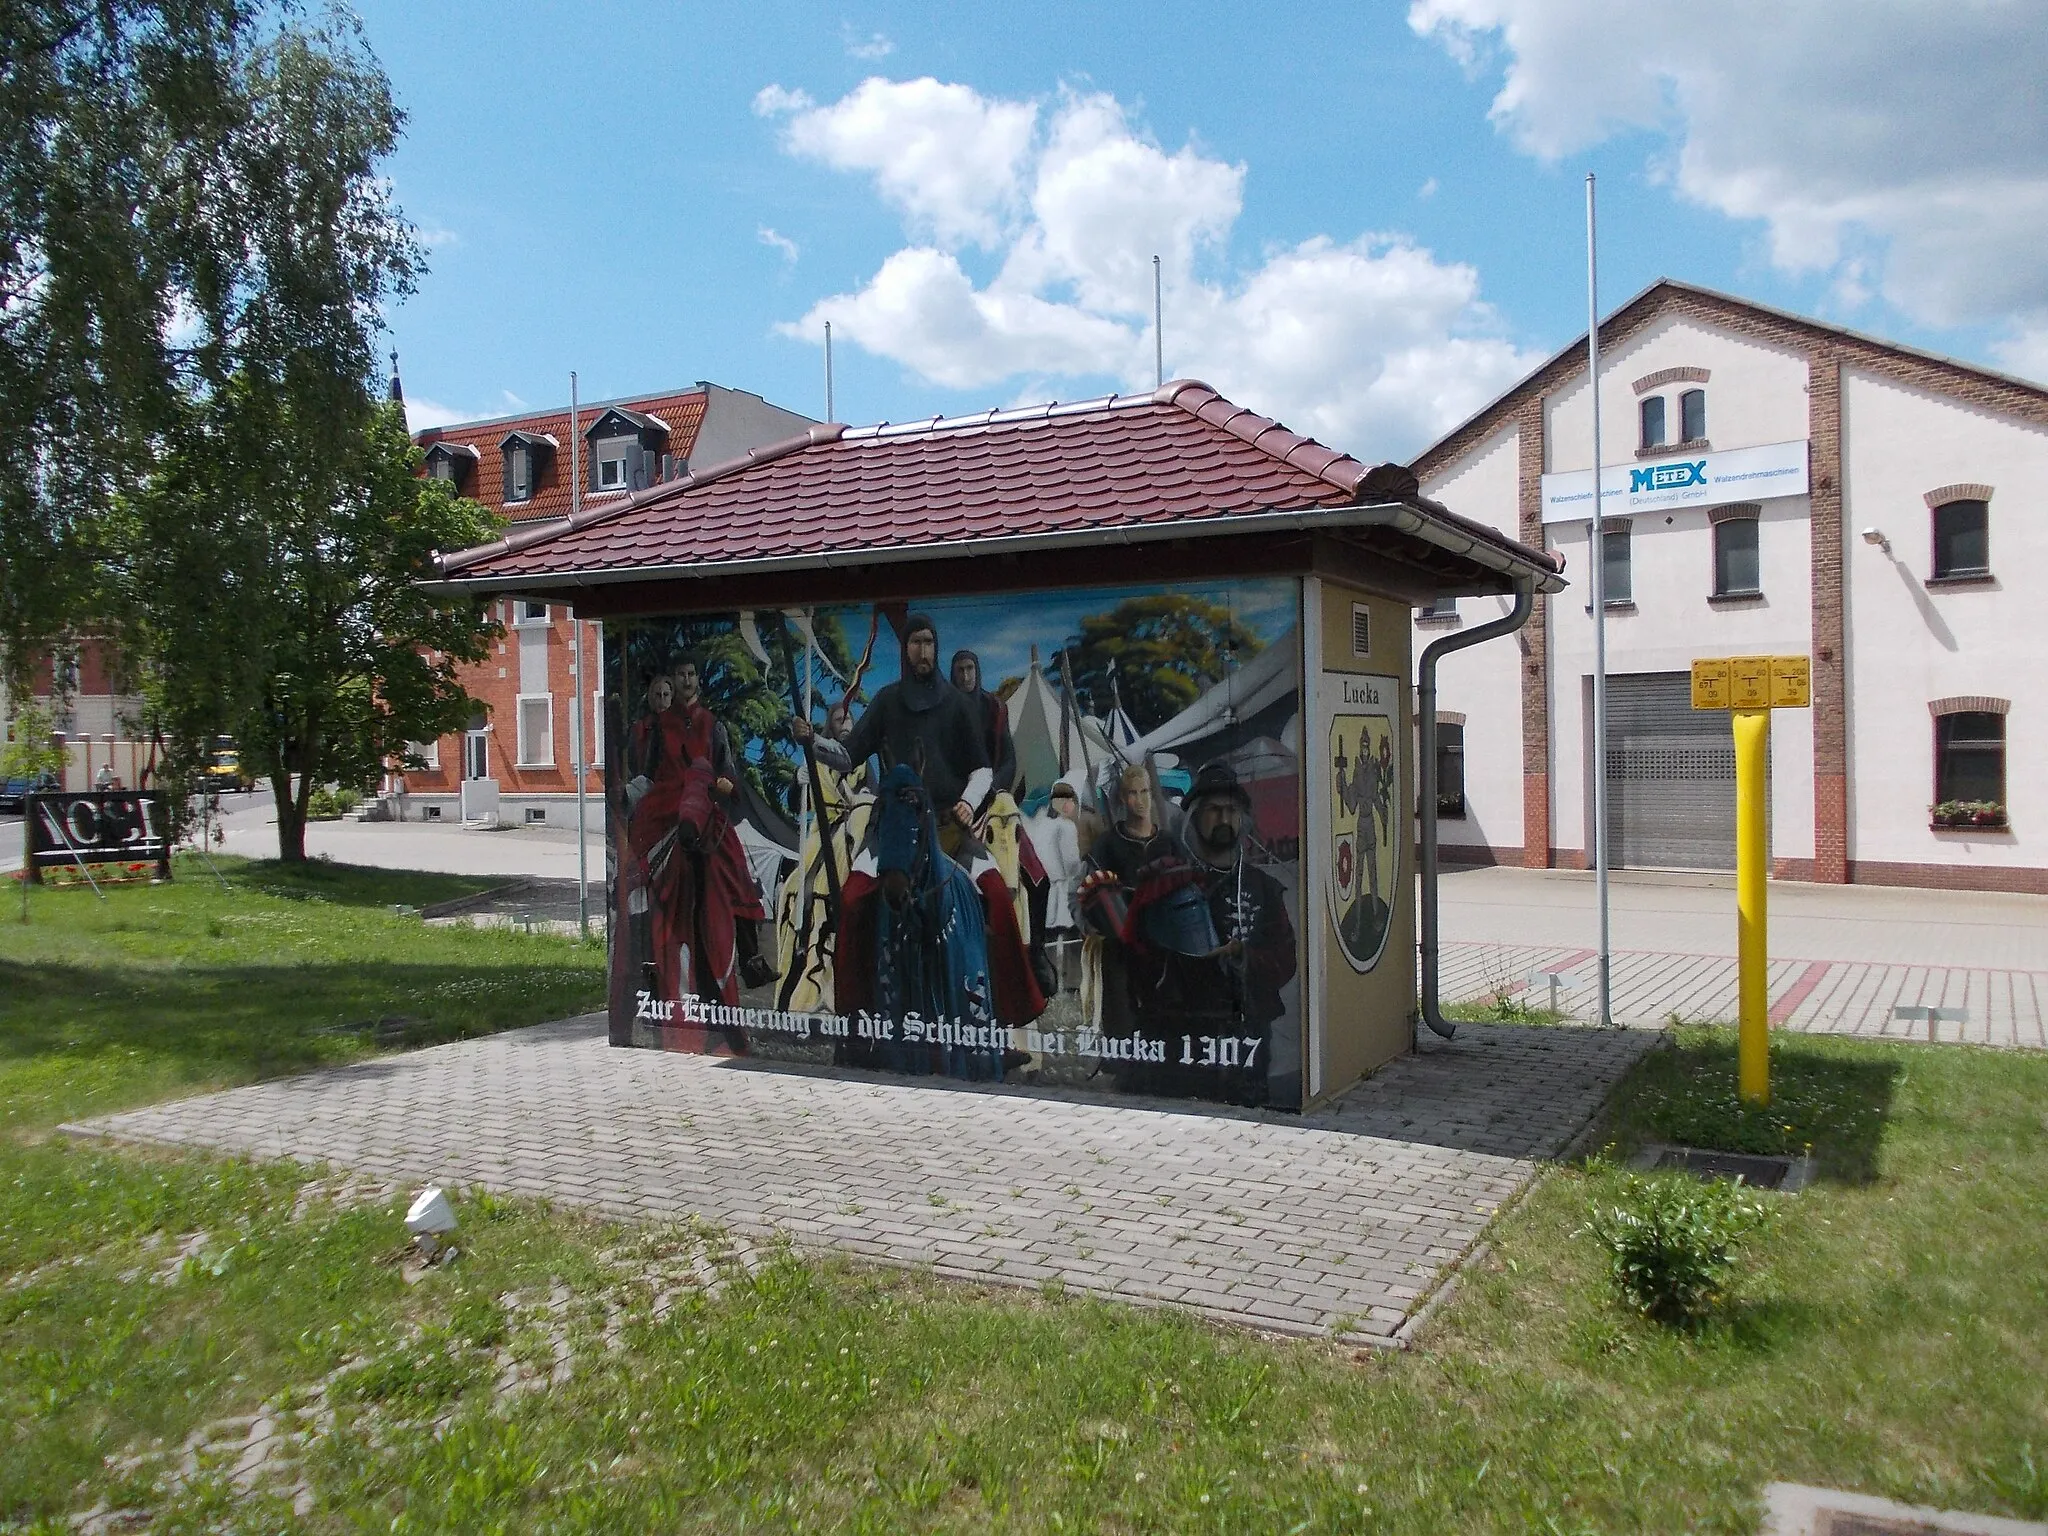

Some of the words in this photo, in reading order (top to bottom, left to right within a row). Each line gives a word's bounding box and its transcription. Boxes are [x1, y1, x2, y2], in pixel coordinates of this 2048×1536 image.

[1629, 460, 1707, 493] METEX
[1681, 490, 1707, 500] GmbH
[1343, 680, 1380, 705] Lucka
[634, 989, 674, 1021] Zur
[682, 993, 812, 1040] Erinnerung
[819, 1013, 849, 1037] an
[857, 1008, 895, 1042] die
[902, 1010, 1016, 1056] Schlacht
[1026, 1026, 1065, 1054] bei
[1075, 1025, 1167, 1063] Lucka
[1178, 1033, 1263, 1068] 1307
